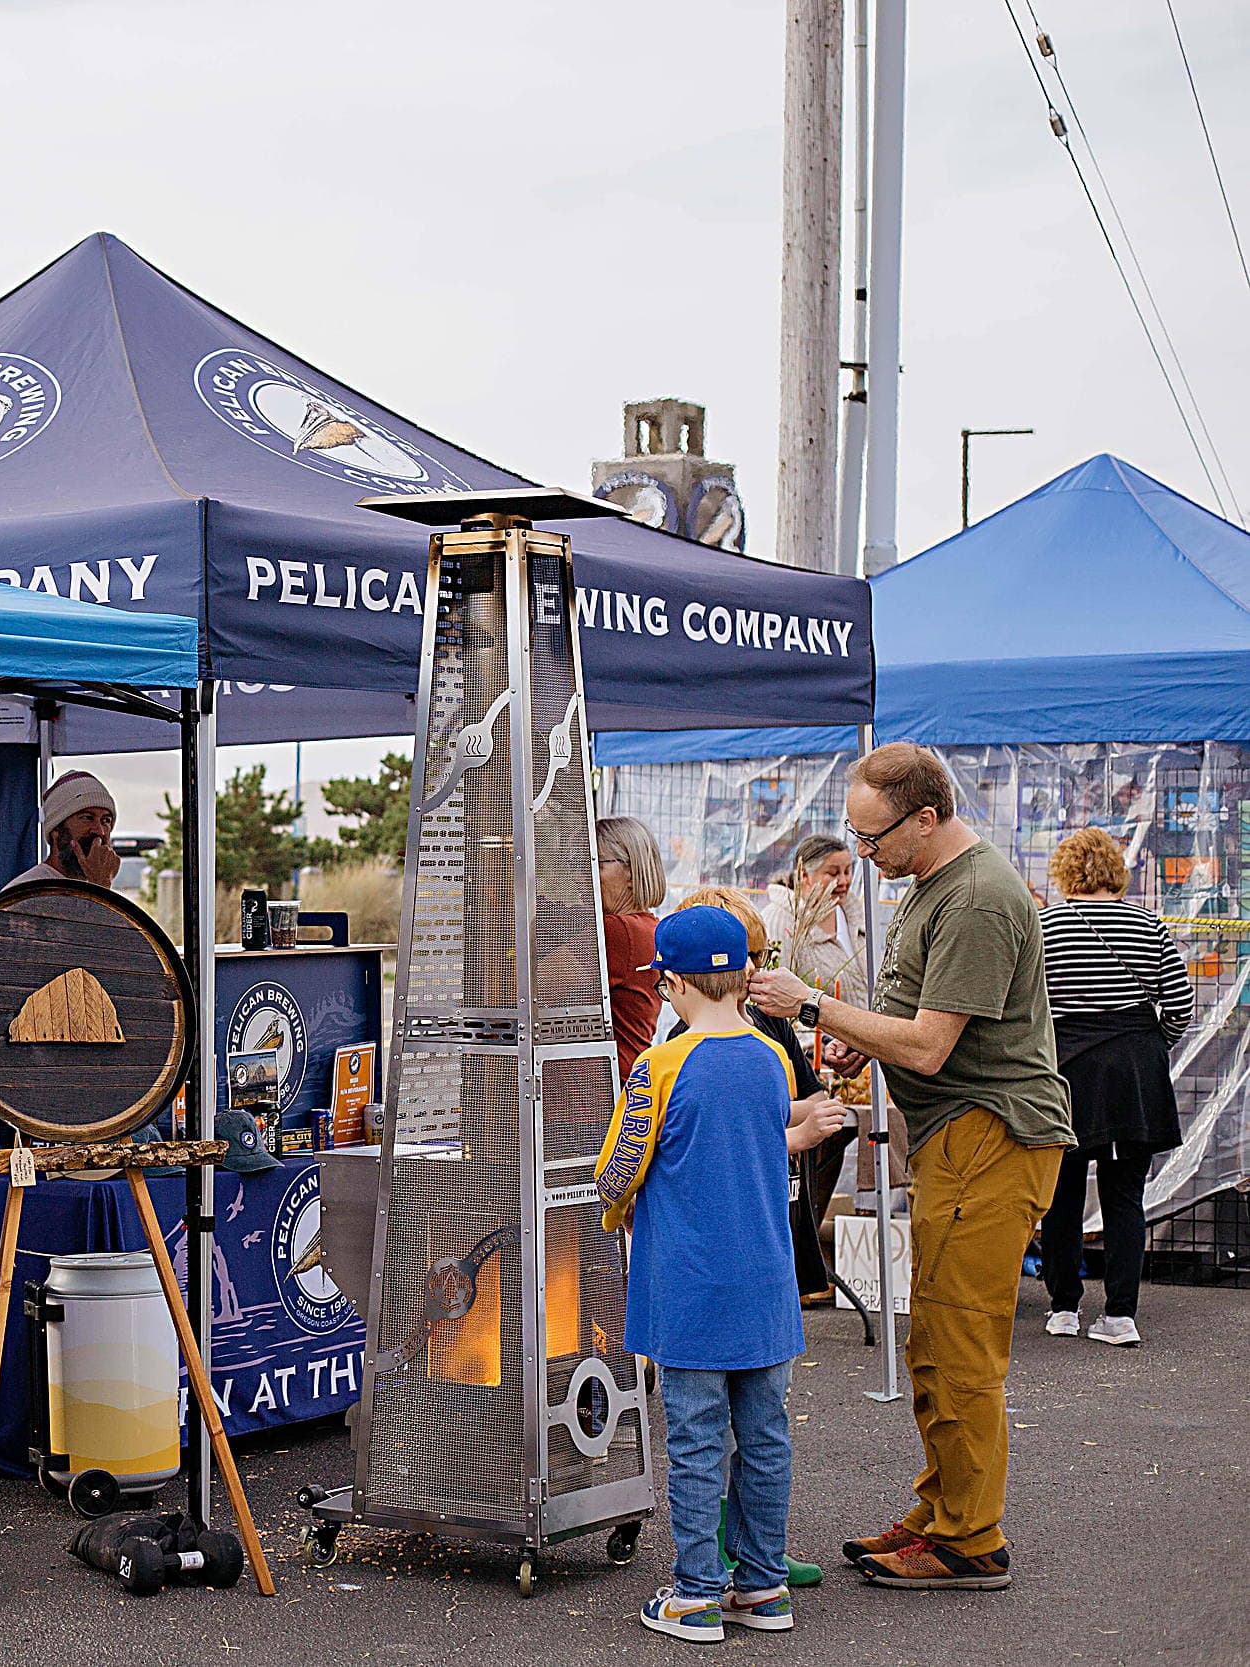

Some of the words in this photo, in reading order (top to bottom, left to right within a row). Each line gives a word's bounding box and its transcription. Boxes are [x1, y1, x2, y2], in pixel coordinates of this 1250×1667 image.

[212, 358, 271, 436] PELICAN
[245, 556, 423, 616] PELICA
[682, 602, 854, 658] COMPANY
[245, 912, 253, 940] CIDER
[267, 989, 304, 1053] BREWING
[268, 1126, 276, 1153] CIDER
[277, 1174, 319, 1259] PELICAN
[296, 1295, 327, 1318] SINCE
[330, 1295, 348, 1315] 199
[296, 1310, 321, 1328] OREGON
[320, 1315, 341, 1328] COAST
[248, 1365, 296, 1413] AT
[307, 1351, 366, 1399] TH
